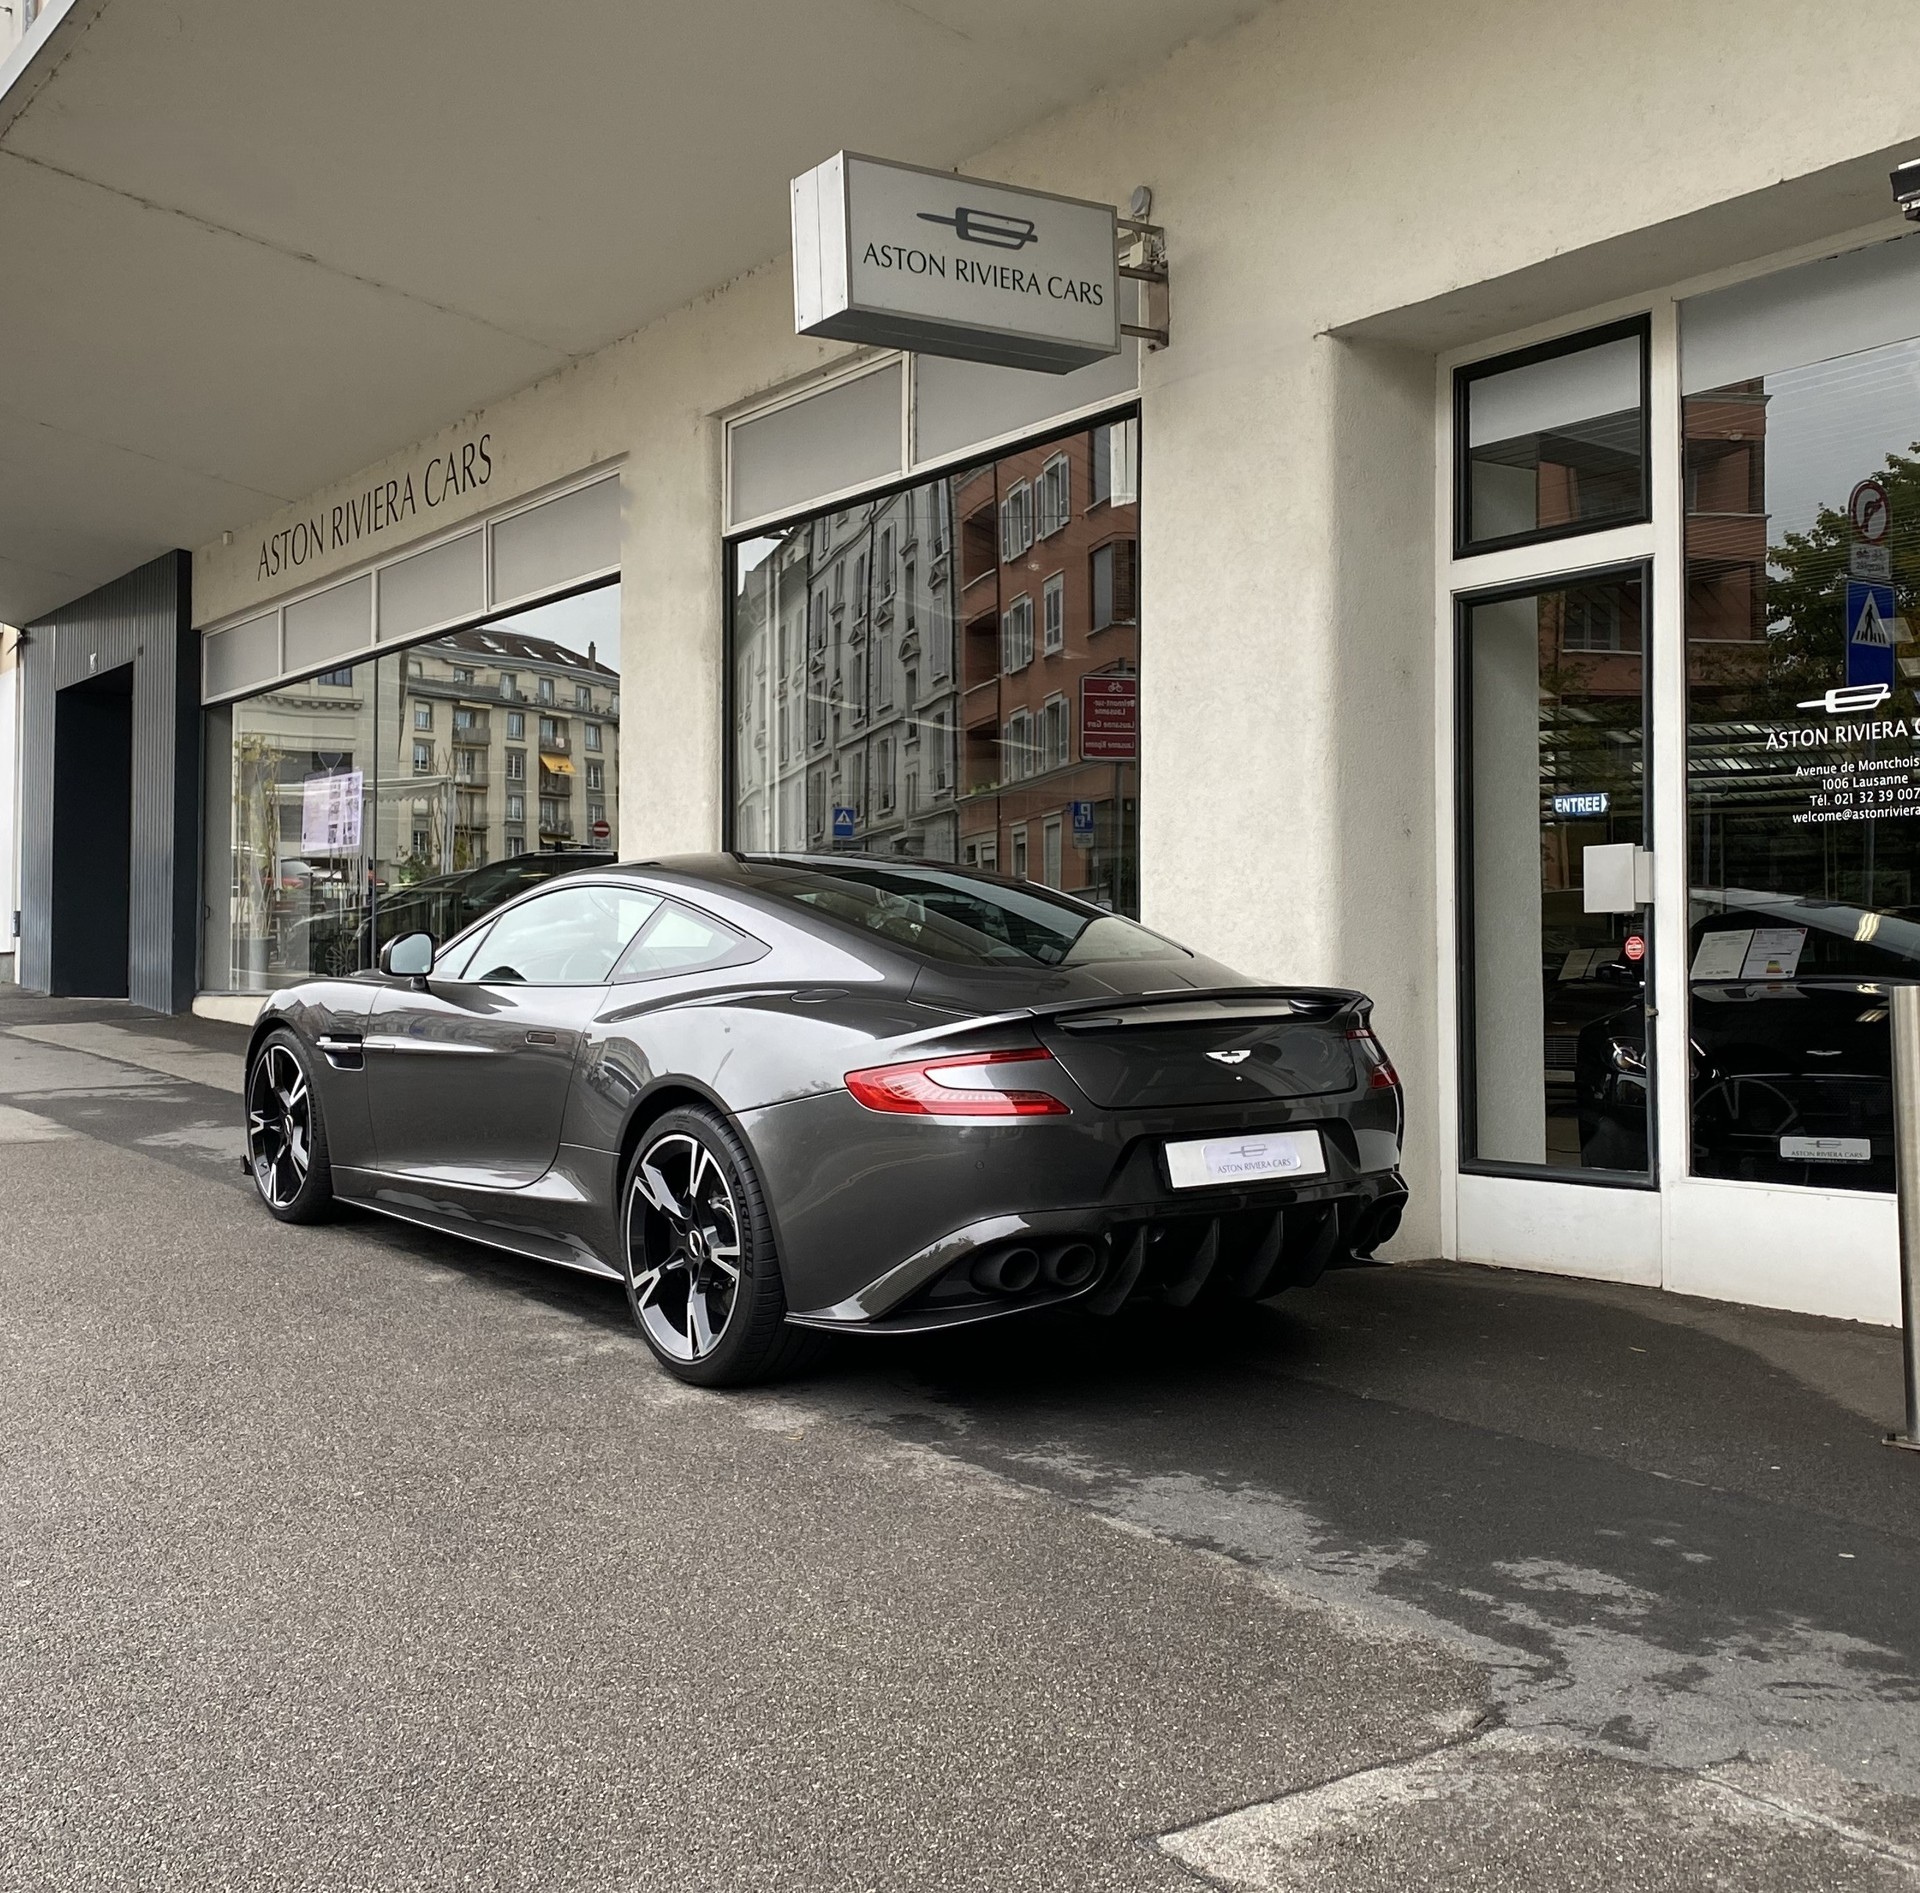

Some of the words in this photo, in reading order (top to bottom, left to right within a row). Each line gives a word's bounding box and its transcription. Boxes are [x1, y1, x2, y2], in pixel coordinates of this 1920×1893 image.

[863, 242, 946, 278] ASTON
[955, 258, 1041, 295] RIVIERA
[1047, 275, 1104, 306] CARS
[257, 513, 324, 582] ASTON
[331, 472, 416, 550] RIVIERA
[424, 434, 492, 507] CARS
[1765, 727, 1828, 750] ASTON
[1835, 719, 1909, 744] RIVIERA
[1795, 765, 1837, 777] Avenue
[1840, 761, 1855, 773] de
[1858, 755, 1920, 772] Montchois
[1822, 777, 1849, 790] 1006
[1852, 774, 1909, 788] Lausanne
[1555, 796, 1600, 813] ENTREE
[1809, 794, 1831, 807] Tél.
[1834, 792, 1854, 805] 021
[1859, 791, 1874, 804] 32
[1878, 789, 1894, 802] 39
[1897, 787, 1920, 801] 007
[1792, 804, 1920, 823] welcome@astonriviera
[1217, 1164, 1243, 1174] ASTON
[1244, 1161, 1272, 1171] RIVIERA
[1272, 1158, 1292, 1168] CARS
[735, 1184, 753, 1273] MICHELIN
